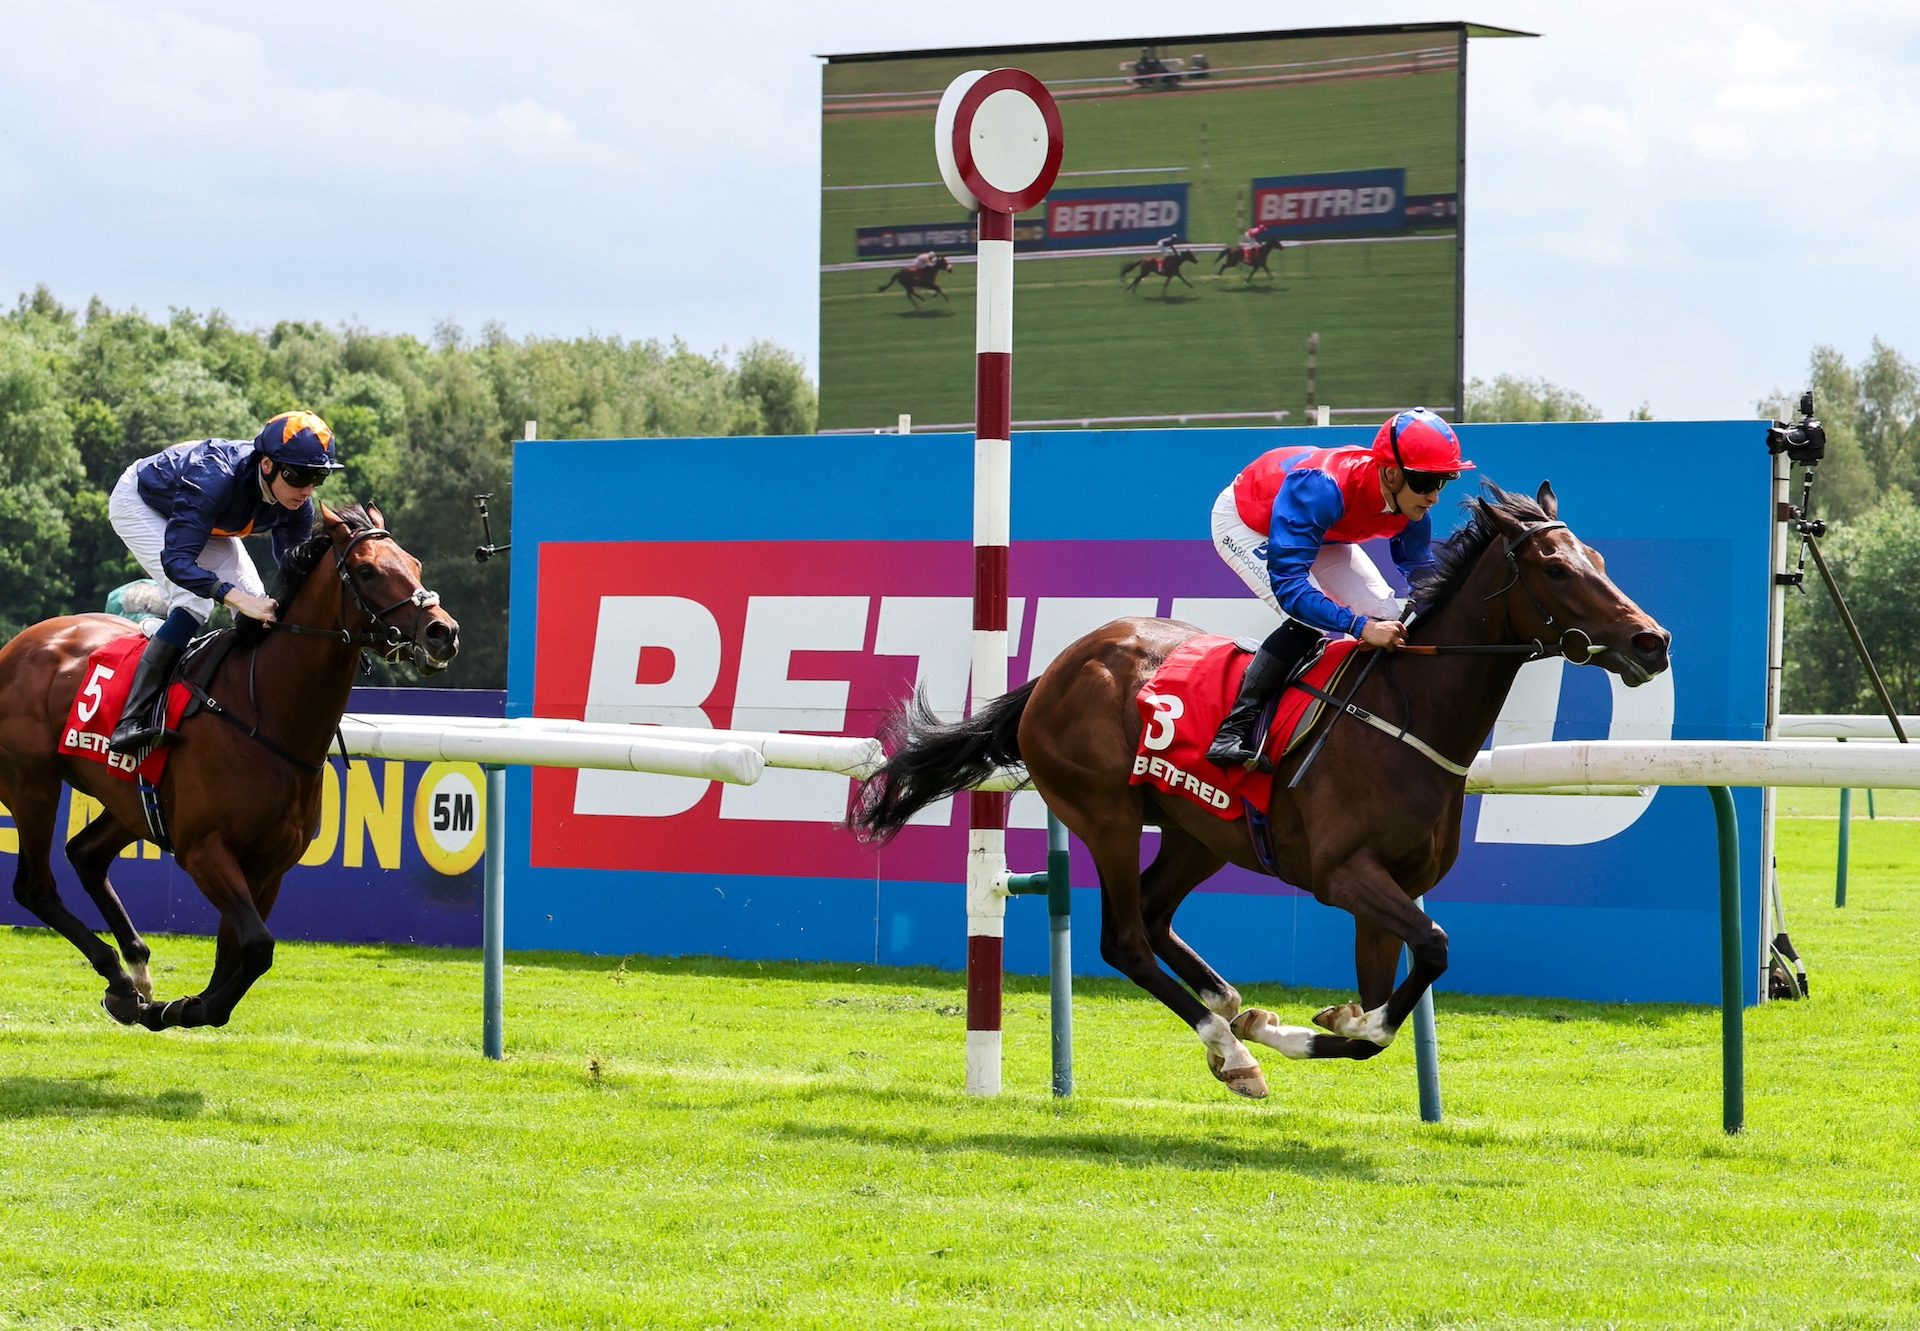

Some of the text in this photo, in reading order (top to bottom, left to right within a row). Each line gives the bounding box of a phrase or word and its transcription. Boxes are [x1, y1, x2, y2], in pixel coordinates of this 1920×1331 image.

[1053, 200, 1180, 232] BETFRED
[1261, 186, 1395, 221] BETFRED
[1222, 535, 1271, 588] BluBloodsto
[77, 663, 115, 723] 5
[573, 595, 1675, 845] BETD
[1144, 694, 1184, 750] 3
[64, 728, 137, 773] BETFED
[1132, 755, 1231, 809] BETFRED
[433, 793, 473, 832] 5M
